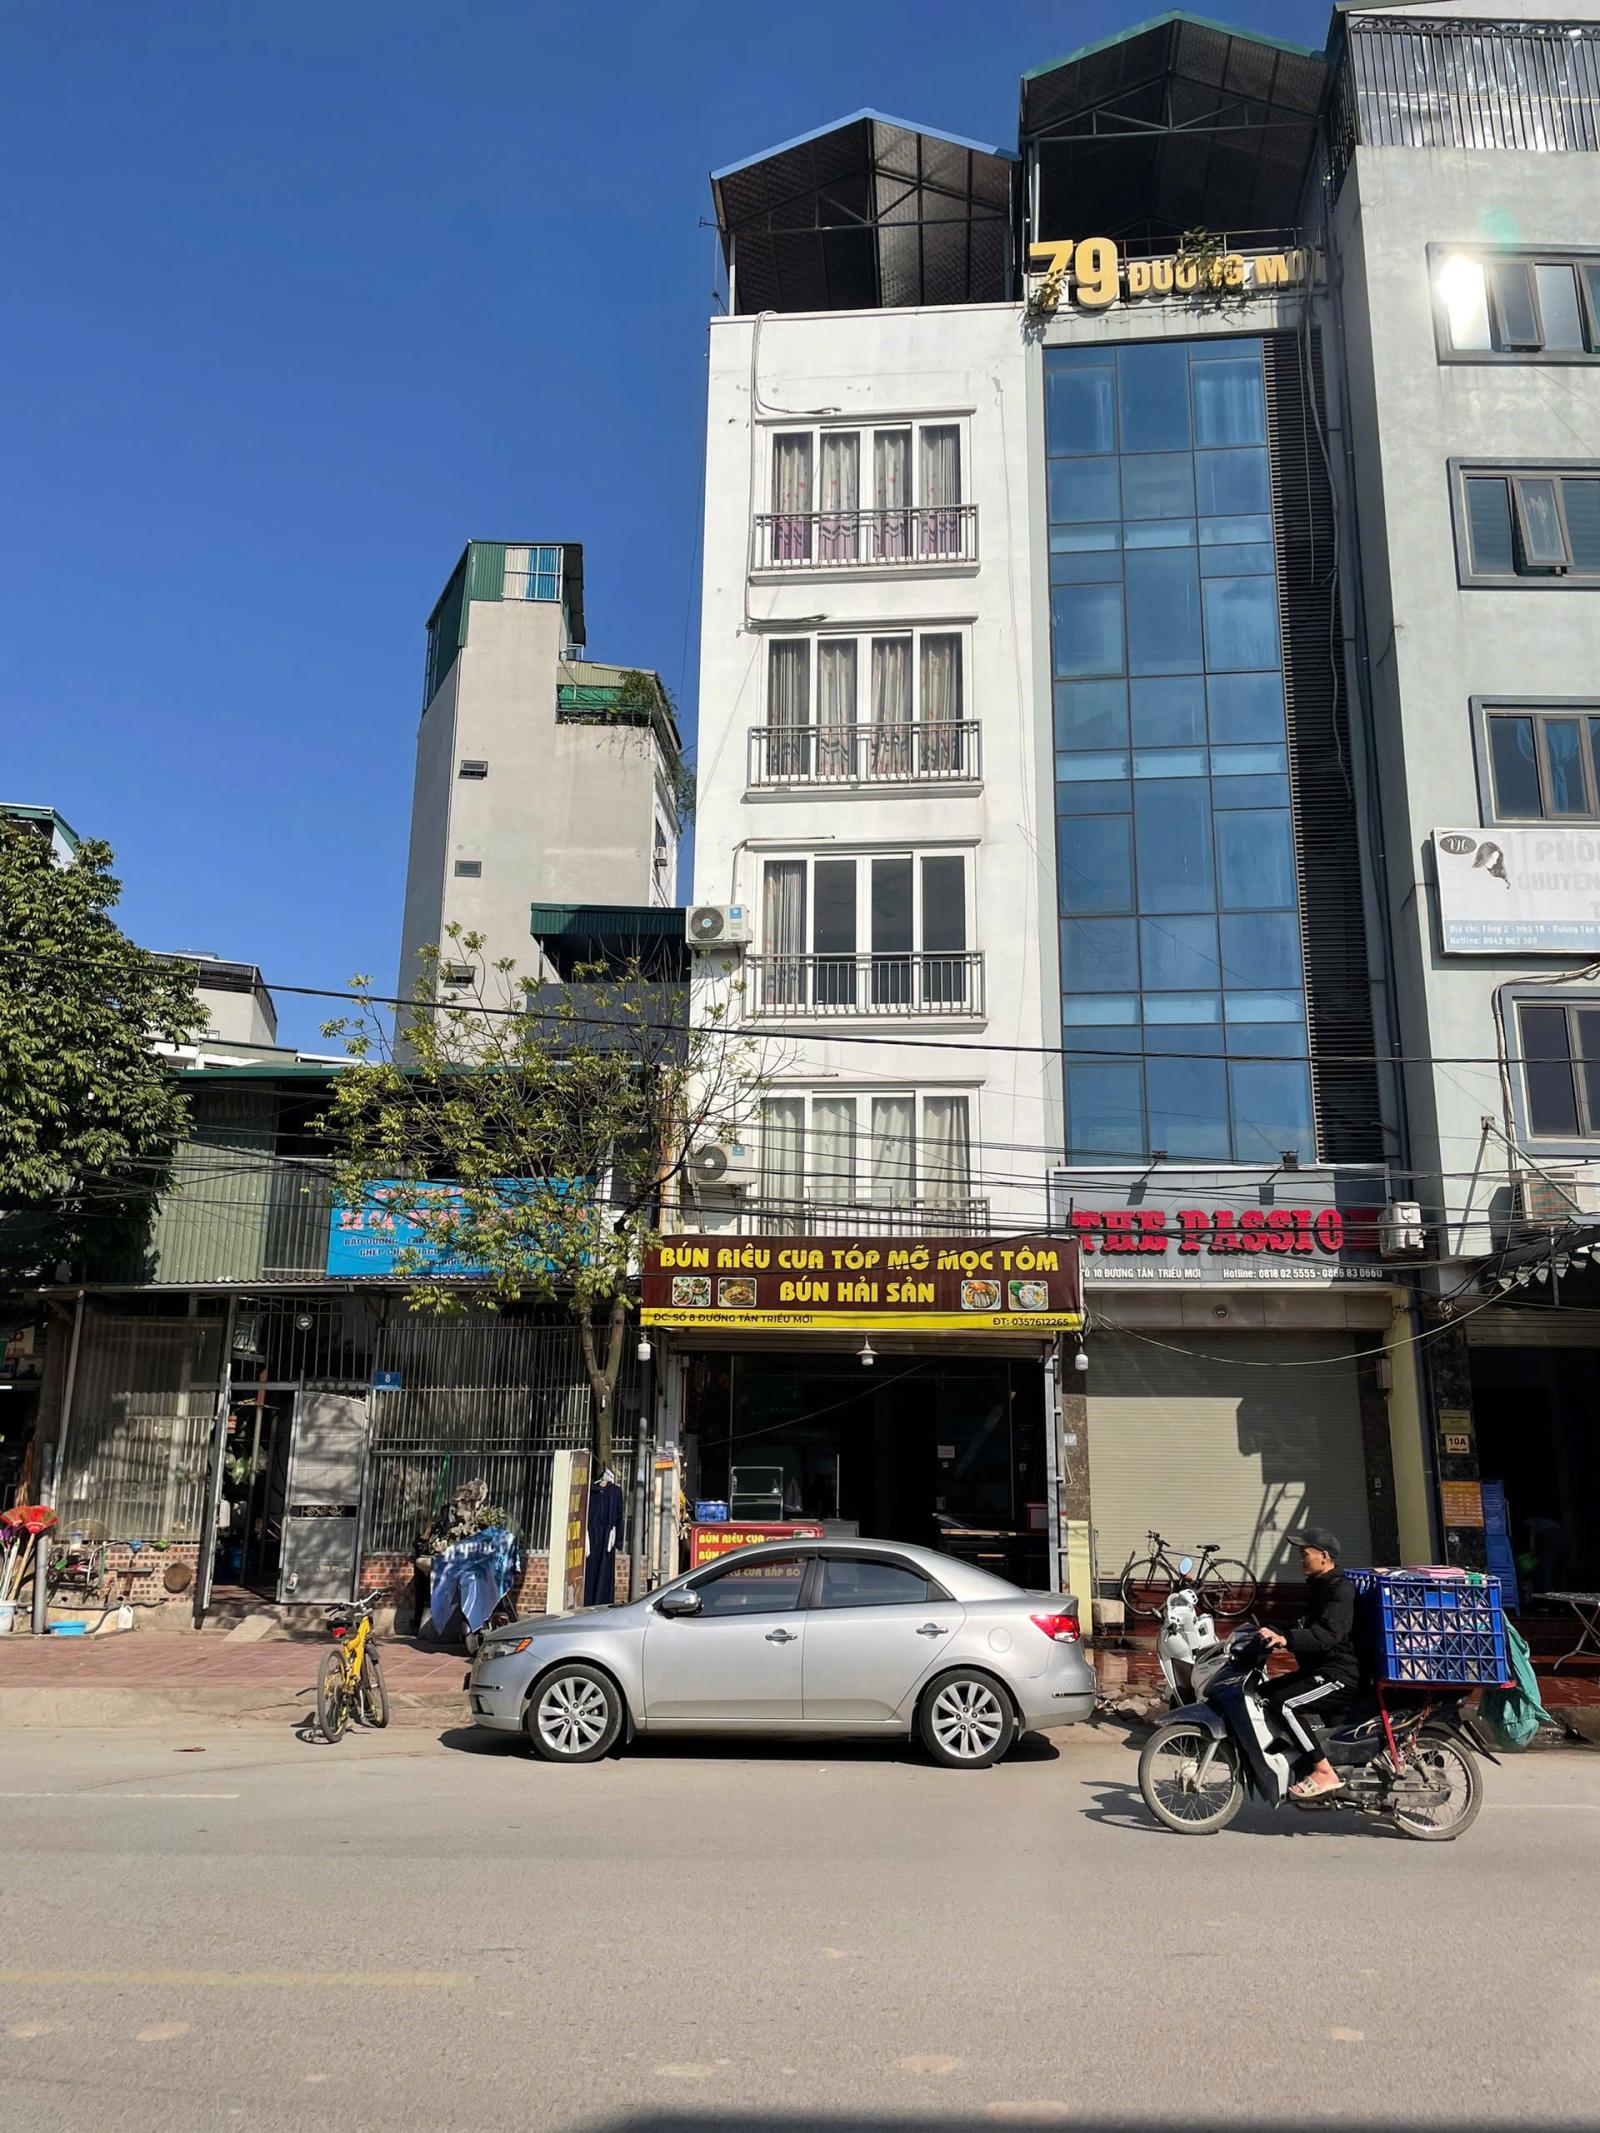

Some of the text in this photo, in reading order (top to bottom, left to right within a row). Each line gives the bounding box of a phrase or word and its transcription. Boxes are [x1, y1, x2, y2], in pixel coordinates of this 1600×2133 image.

[1029, 237, 1118, 308] 79
[1071, 1209, 1168, 1254] THE
[660, 1241, 1059, 1278] BÚN RIÊU CUA TÓP MỠ MỌC TÔM
[1093, 1268, 1102, 1278] 10
[1104, 1266, 1134, 1279] ĐƯỜNG
[1136, 1266, 1154, 1278] TÂN
[1184, 1265, 1201, 1278] MỚI
[1223, 1268, 1257, 1279] Hotline:
[1258, 1268, 1279, 1279] 0818
[1280, 1268, 1291, 1279] 02
[1292, 1268, 1316, 1279] 5555
[1346, 1268, 1358, 1278] 83
[779, 1275, 935, 1303] BÚN HẢI SẢN
[673, 1311, 687, 1322] SỐ
[689, 1313, 696, 1322] 8
[698, 1312, 736, 1323] ĐƯỜNG
[739, 1312, 758, 1323] TÂN
[793, 1312, 813, 1324] MỚI
[993, 1317, 1009, 1326] ĐT:
[384, 1374, 391, 1383] 8
[1448, 1437, 1466, 1446] 10A
[698, 1531, 765, 1544] BÚN RIÊU CUA
[698, 1547, 720, 1560] BÚN
[743, 1567, 762, 1577] CUA
